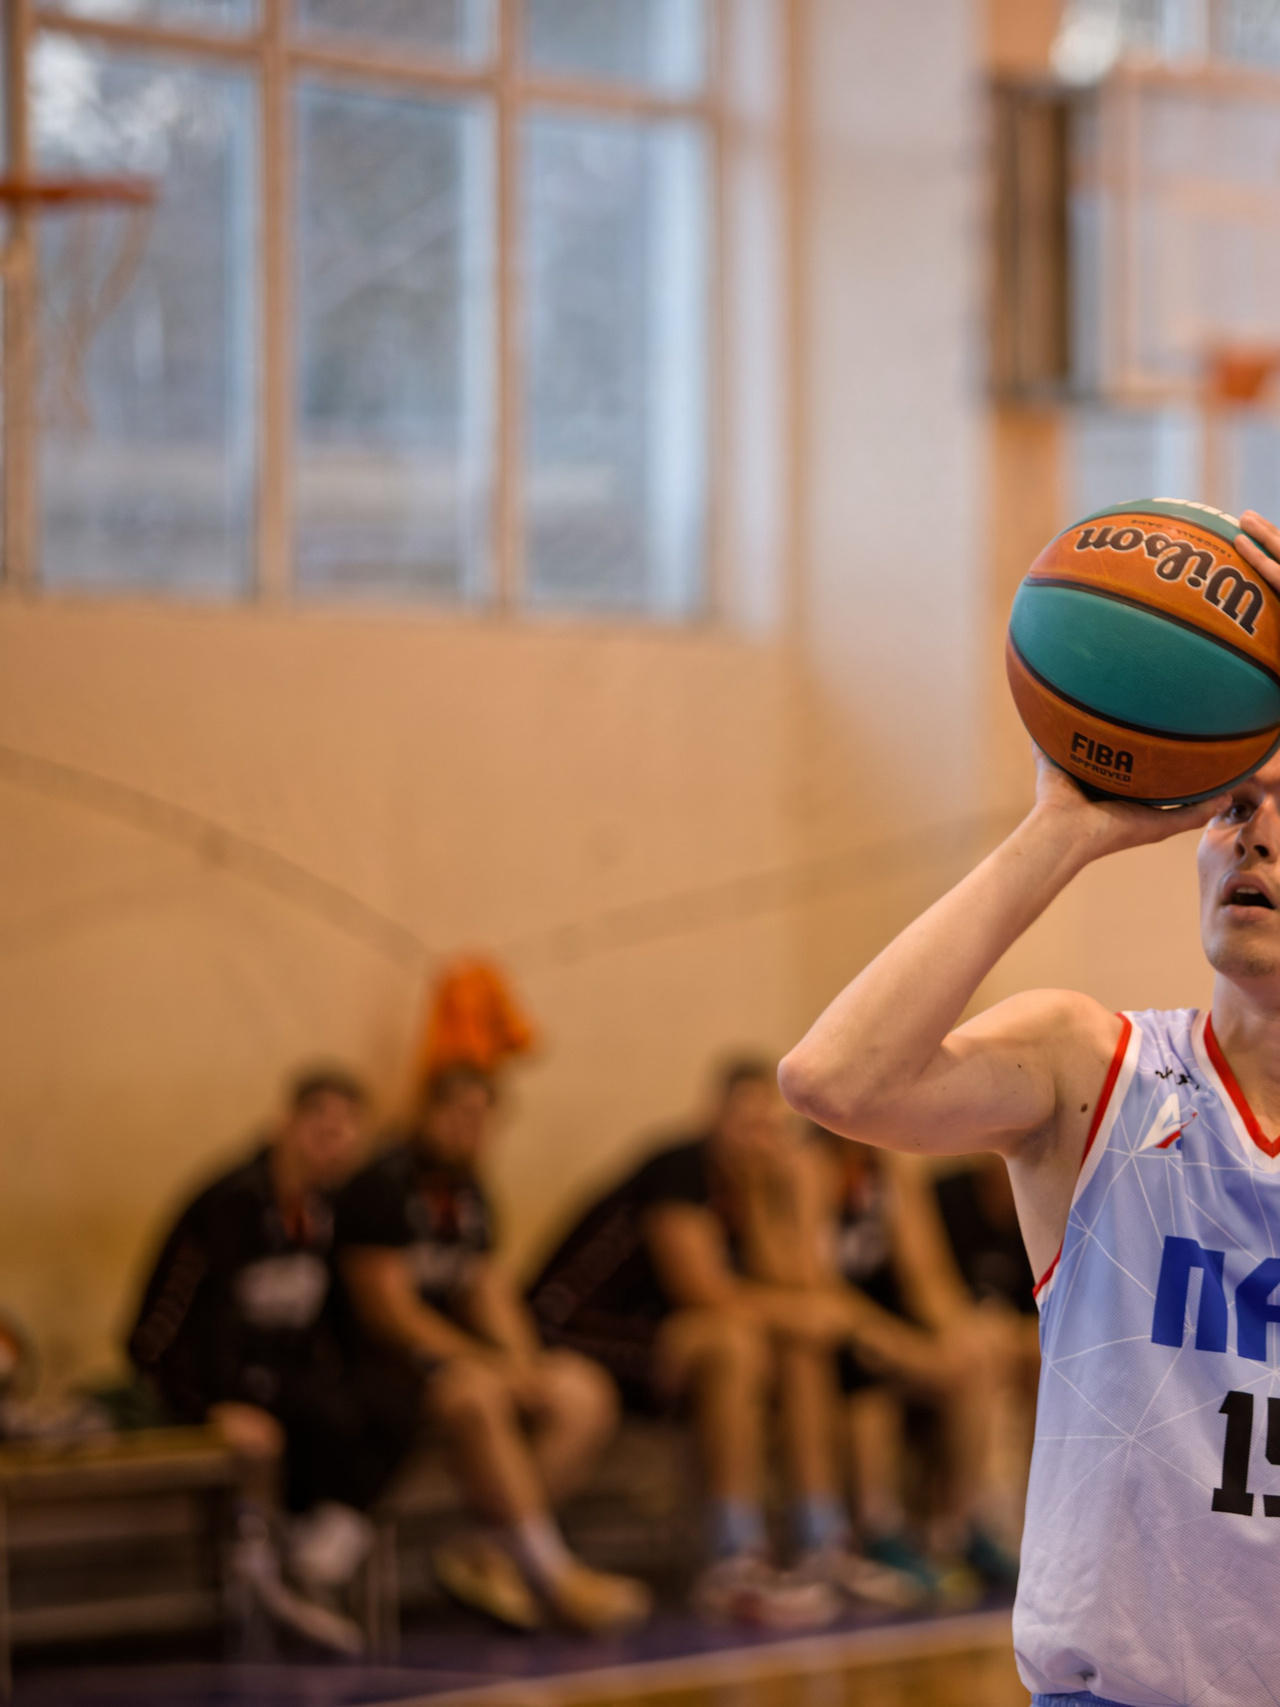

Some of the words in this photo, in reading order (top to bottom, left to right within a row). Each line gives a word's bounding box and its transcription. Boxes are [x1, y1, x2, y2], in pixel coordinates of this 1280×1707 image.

[1074, 525, 1264, 638] Wilson
[1070, 753, 1131, 782] APPROVED
[1071, 731, 1134, 774] FIBA
